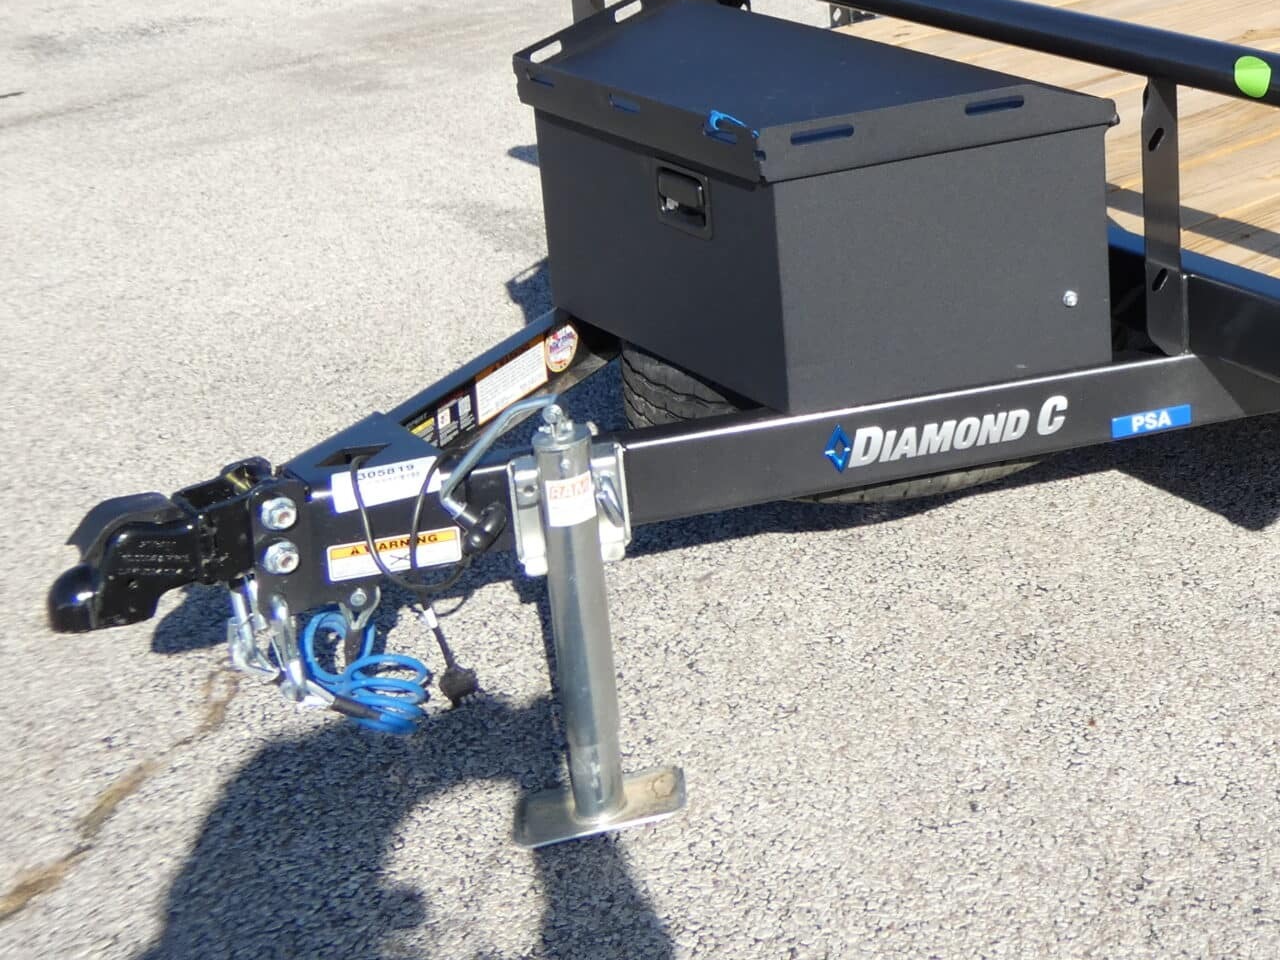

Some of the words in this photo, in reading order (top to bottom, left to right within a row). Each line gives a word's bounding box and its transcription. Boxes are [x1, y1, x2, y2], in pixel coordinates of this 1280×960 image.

[848, 408, 1031, 469] DIAMOND
[1036, 394, 1069, 437] C
[1131, 410, 1173, 433] PSA
[364, 534, 439, 554] ARNNG
